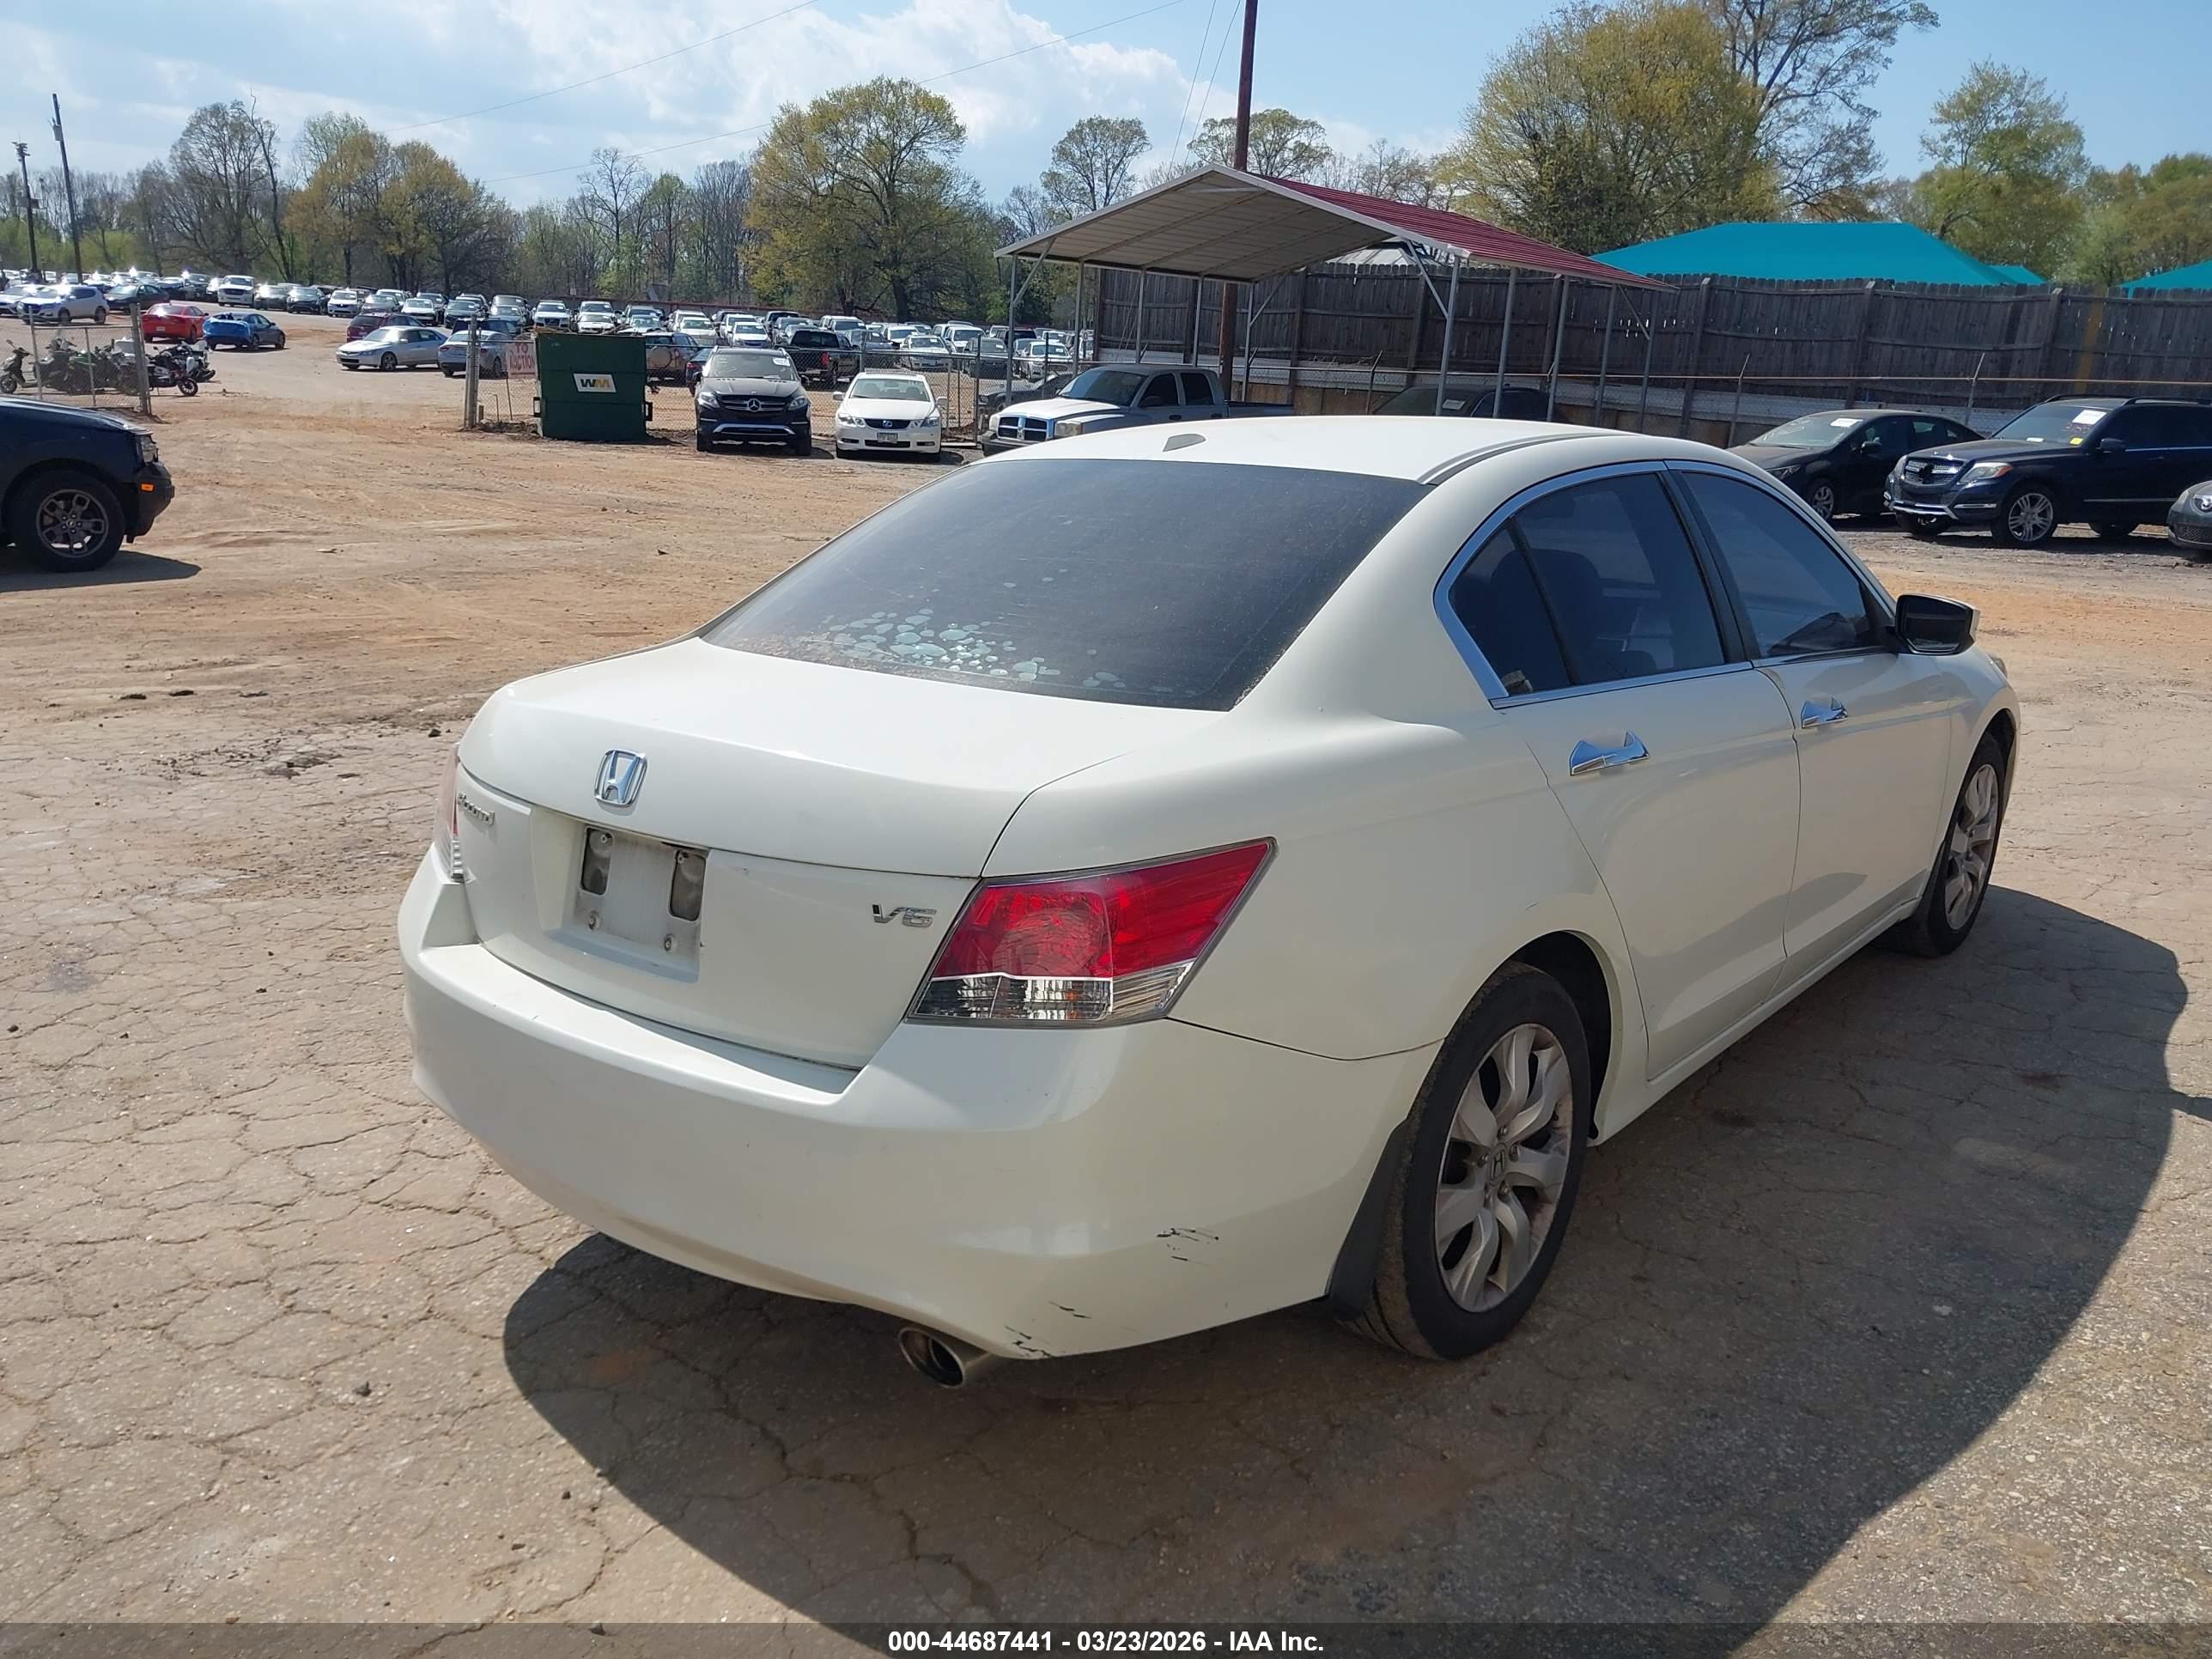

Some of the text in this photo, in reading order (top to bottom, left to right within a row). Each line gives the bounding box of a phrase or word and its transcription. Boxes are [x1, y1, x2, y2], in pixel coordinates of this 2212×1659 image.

[514, 343, 528, 353] TO
[509, 354, 535, 369] AUCTION
[580, 379, 610, 388] WM
[872, 904, 937, 928] V6
